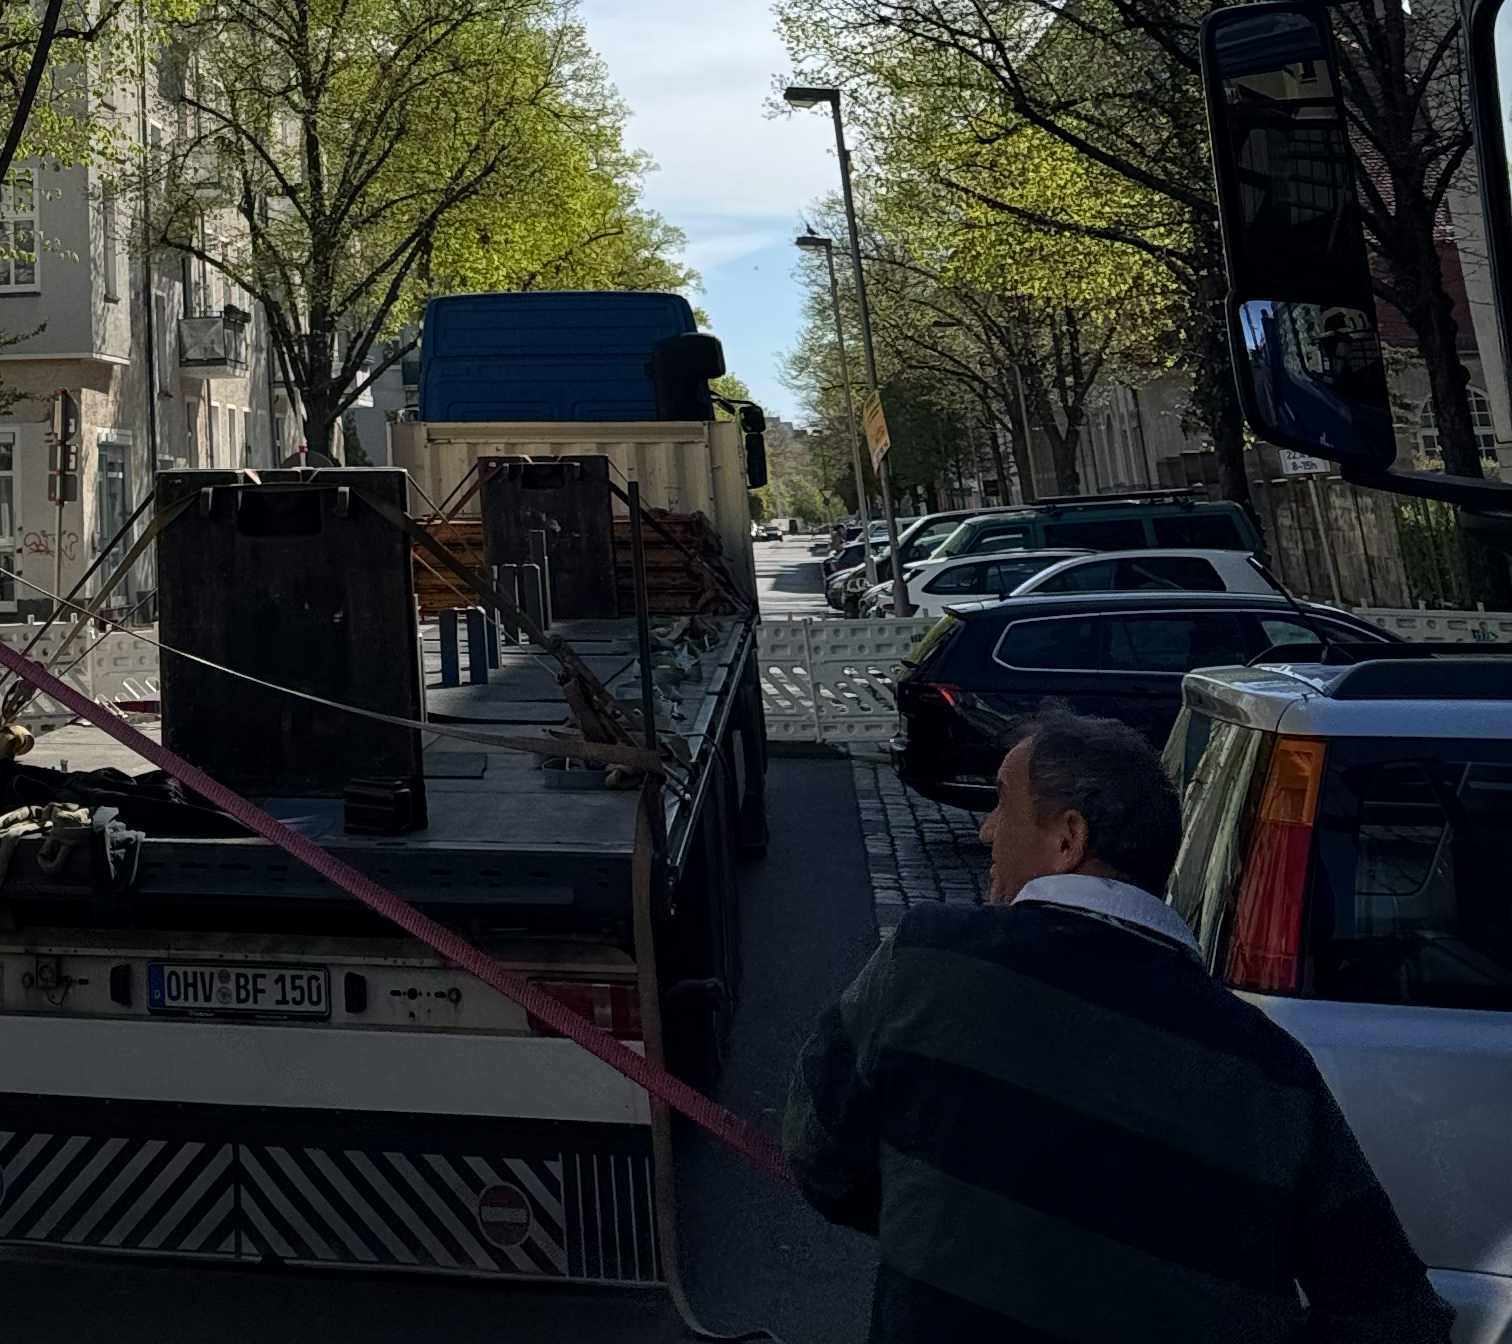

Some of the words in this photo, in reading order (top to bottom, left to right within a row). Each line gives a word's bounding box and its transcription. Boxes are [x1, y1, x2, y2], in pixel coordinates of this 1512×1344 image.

[167, 970, 215, 1003] OHV
[235, 971, 267, 1005] BF
[274, 974, 322, 1007] 150
